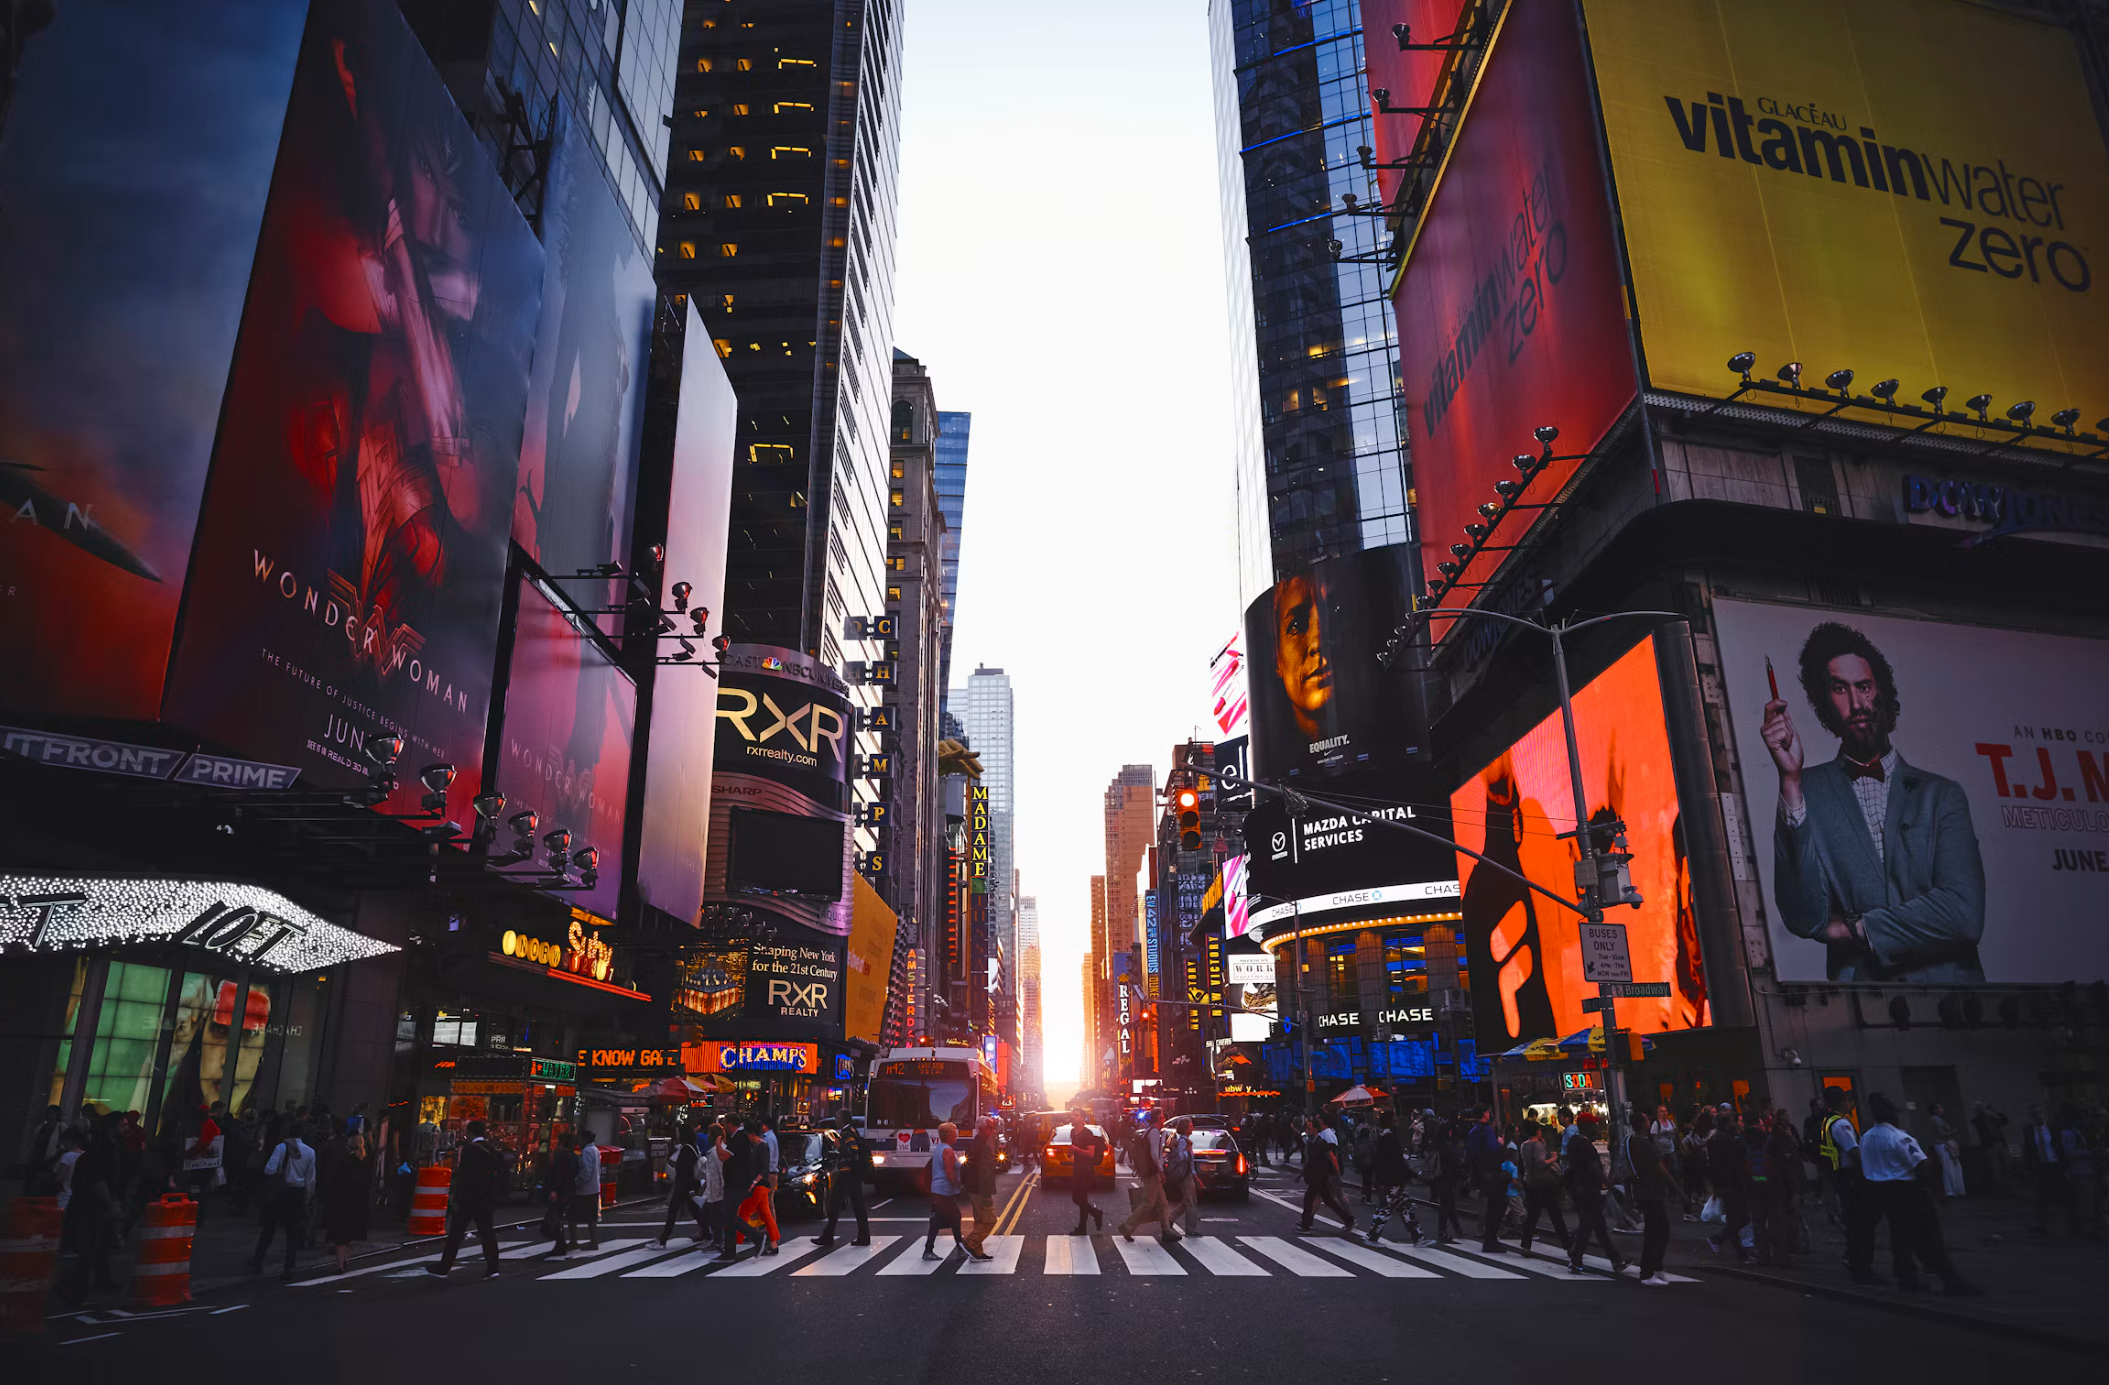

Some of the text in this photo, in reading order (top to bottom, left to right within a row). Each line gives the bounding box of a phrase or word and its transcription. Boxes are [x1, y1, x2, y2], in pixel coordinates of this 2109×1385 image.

[1939, 216, 2093, 293] zero
[1502, 220, 1567, 368] zero
[254, 549, 468, 714] WONDER WOMAN
[262, 648, 446, 759] THE FUTURE OF JUSTICE BEGINS WITH HER
[324, 714, 372, 752] JUN
[716, 687, 844, 764] RXR
[2014, 725, 2035, 740] AN
[2041, 727, 2078, 742] HBO
[1309, 735, 1350, 753] EQUALITY.
[511, 738, 571, 795] WONDER
[746, 746, 818, 767] rxrrealty.com
[193, 759, 287, 789] PRIME
[711, 785, 763, 796] SHARP
[972, 786, 987, 877] MADAME
[1303, 816, 1348, 835] MAZDA
[1304, 829, 1363, 851] SERVICES
[1332, 892, 1370, 906] CHASE
[1589, 928, 1618, 939] BUSES
[800, 947, 820, 960] New
[821, 950, 836, 963] York
[1594, 941, 1616, 951] ONLY
[752, 959, 838, 982] for the 21st Century
[1209, 936, 1222, 986] VICTORY
[1235, 964, 1274, 973] WORK
[768, 979, 828, 1010] RXR
[1625, 985, 1668, 995] Broadway
[780, 1007, 819, 1017] REALTY
[1119, 985, 1130, 1054] REGAL
[1319, 1008, 1433, 1027] CHASE CHASE
[592, 1049, 635, 1066] KNOW
[720, 1046, 807, 1068] CHAMPS
[1565, 1074, 1593, 1089] SODA
